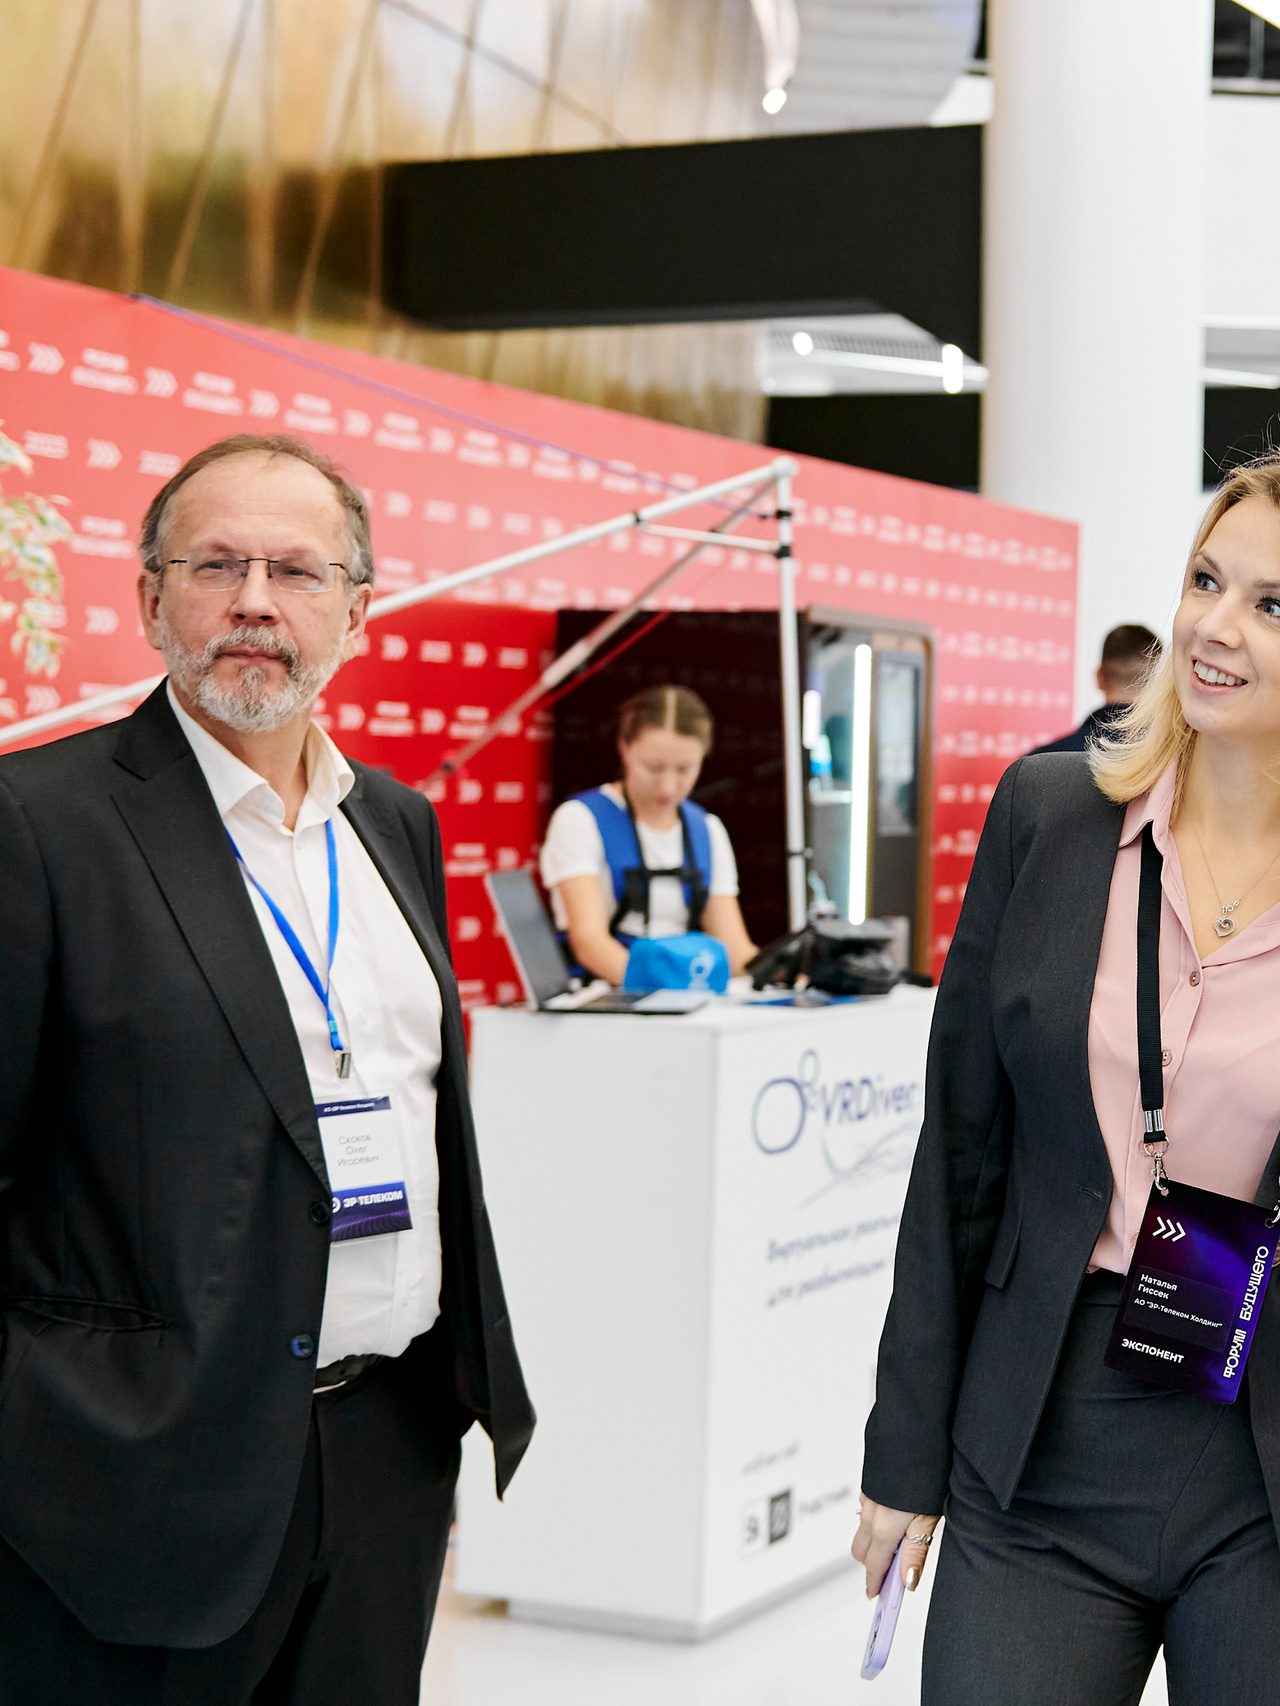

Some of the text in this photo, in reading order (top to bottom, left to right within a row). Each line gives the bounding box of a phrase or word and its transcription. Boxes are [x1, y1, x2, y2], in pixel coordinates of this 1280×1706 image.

[821, 1075, 918, 1125] VRDiver
[338, 1134, 372, 1145] Скоков
[345, 1145, 367, 1155] Олег
[337, 1156, 380, 1167] Игоревич
[1140, 1273, 1178, 1291] Наталья
[1137, 1283, 1170, 1300] Гиссек
[1133, 1297, 1146, 1307] АО
[1121, 1338, 1185, 1364] ЭКСПОНЕНТ
[1222, 1328, 1247, 1379] ФОРУМ
